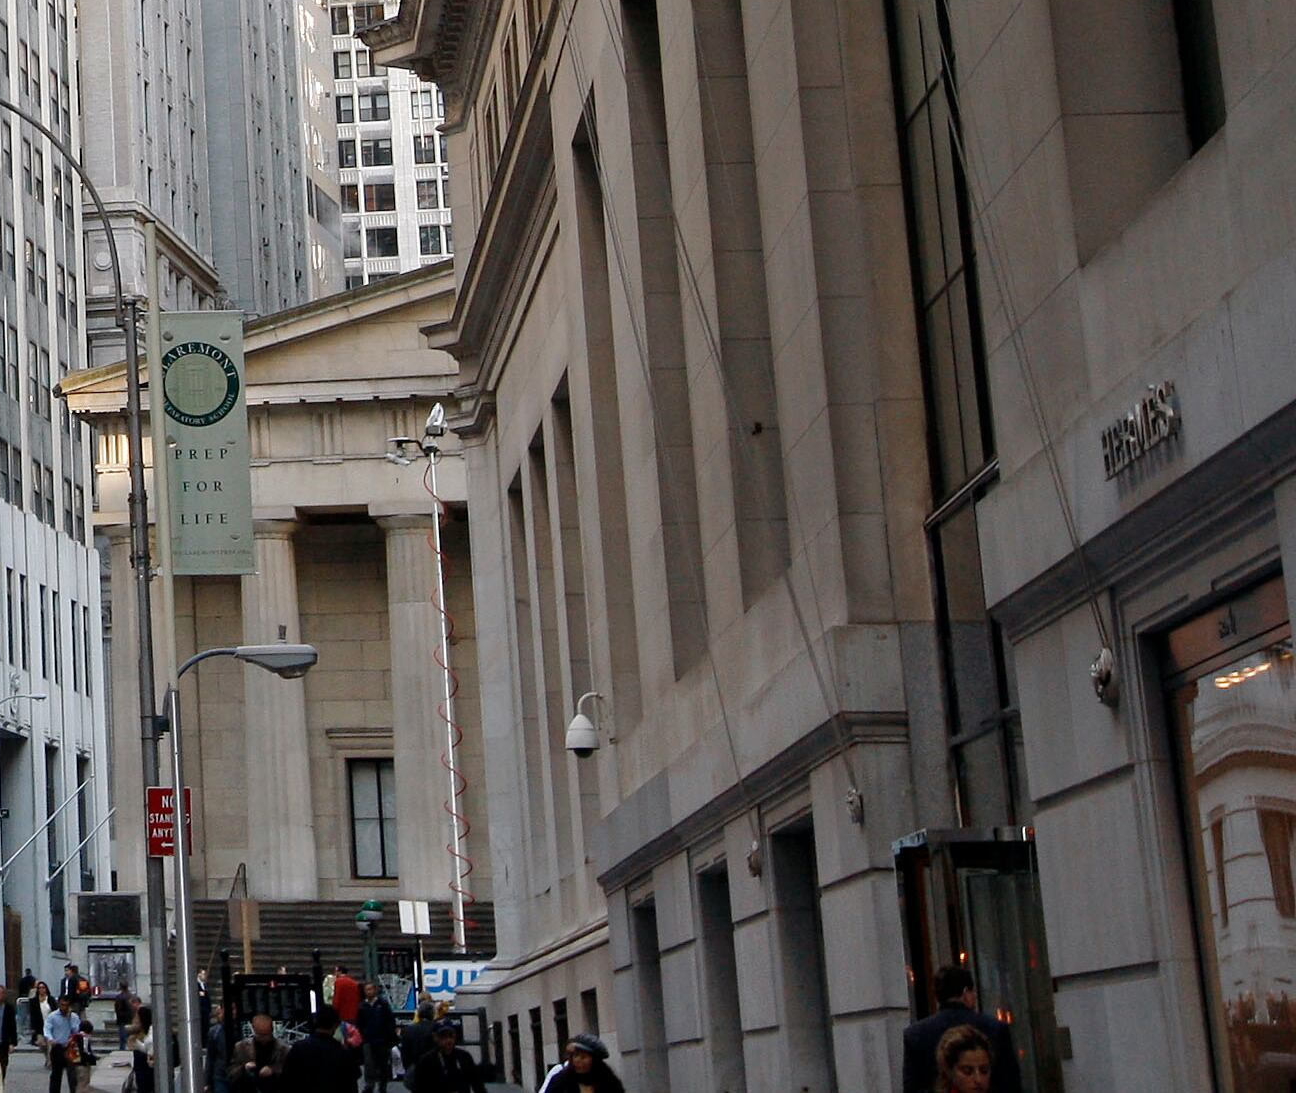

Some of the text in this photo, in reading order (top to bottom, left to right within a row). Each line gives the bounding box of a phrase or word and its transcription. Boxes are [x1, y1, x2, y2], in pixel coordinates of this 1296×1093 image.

[174, 448, 228, 460] PREP
[182, 480, 224, 493] FOR
[180, 513, 229, 525] LIFE
